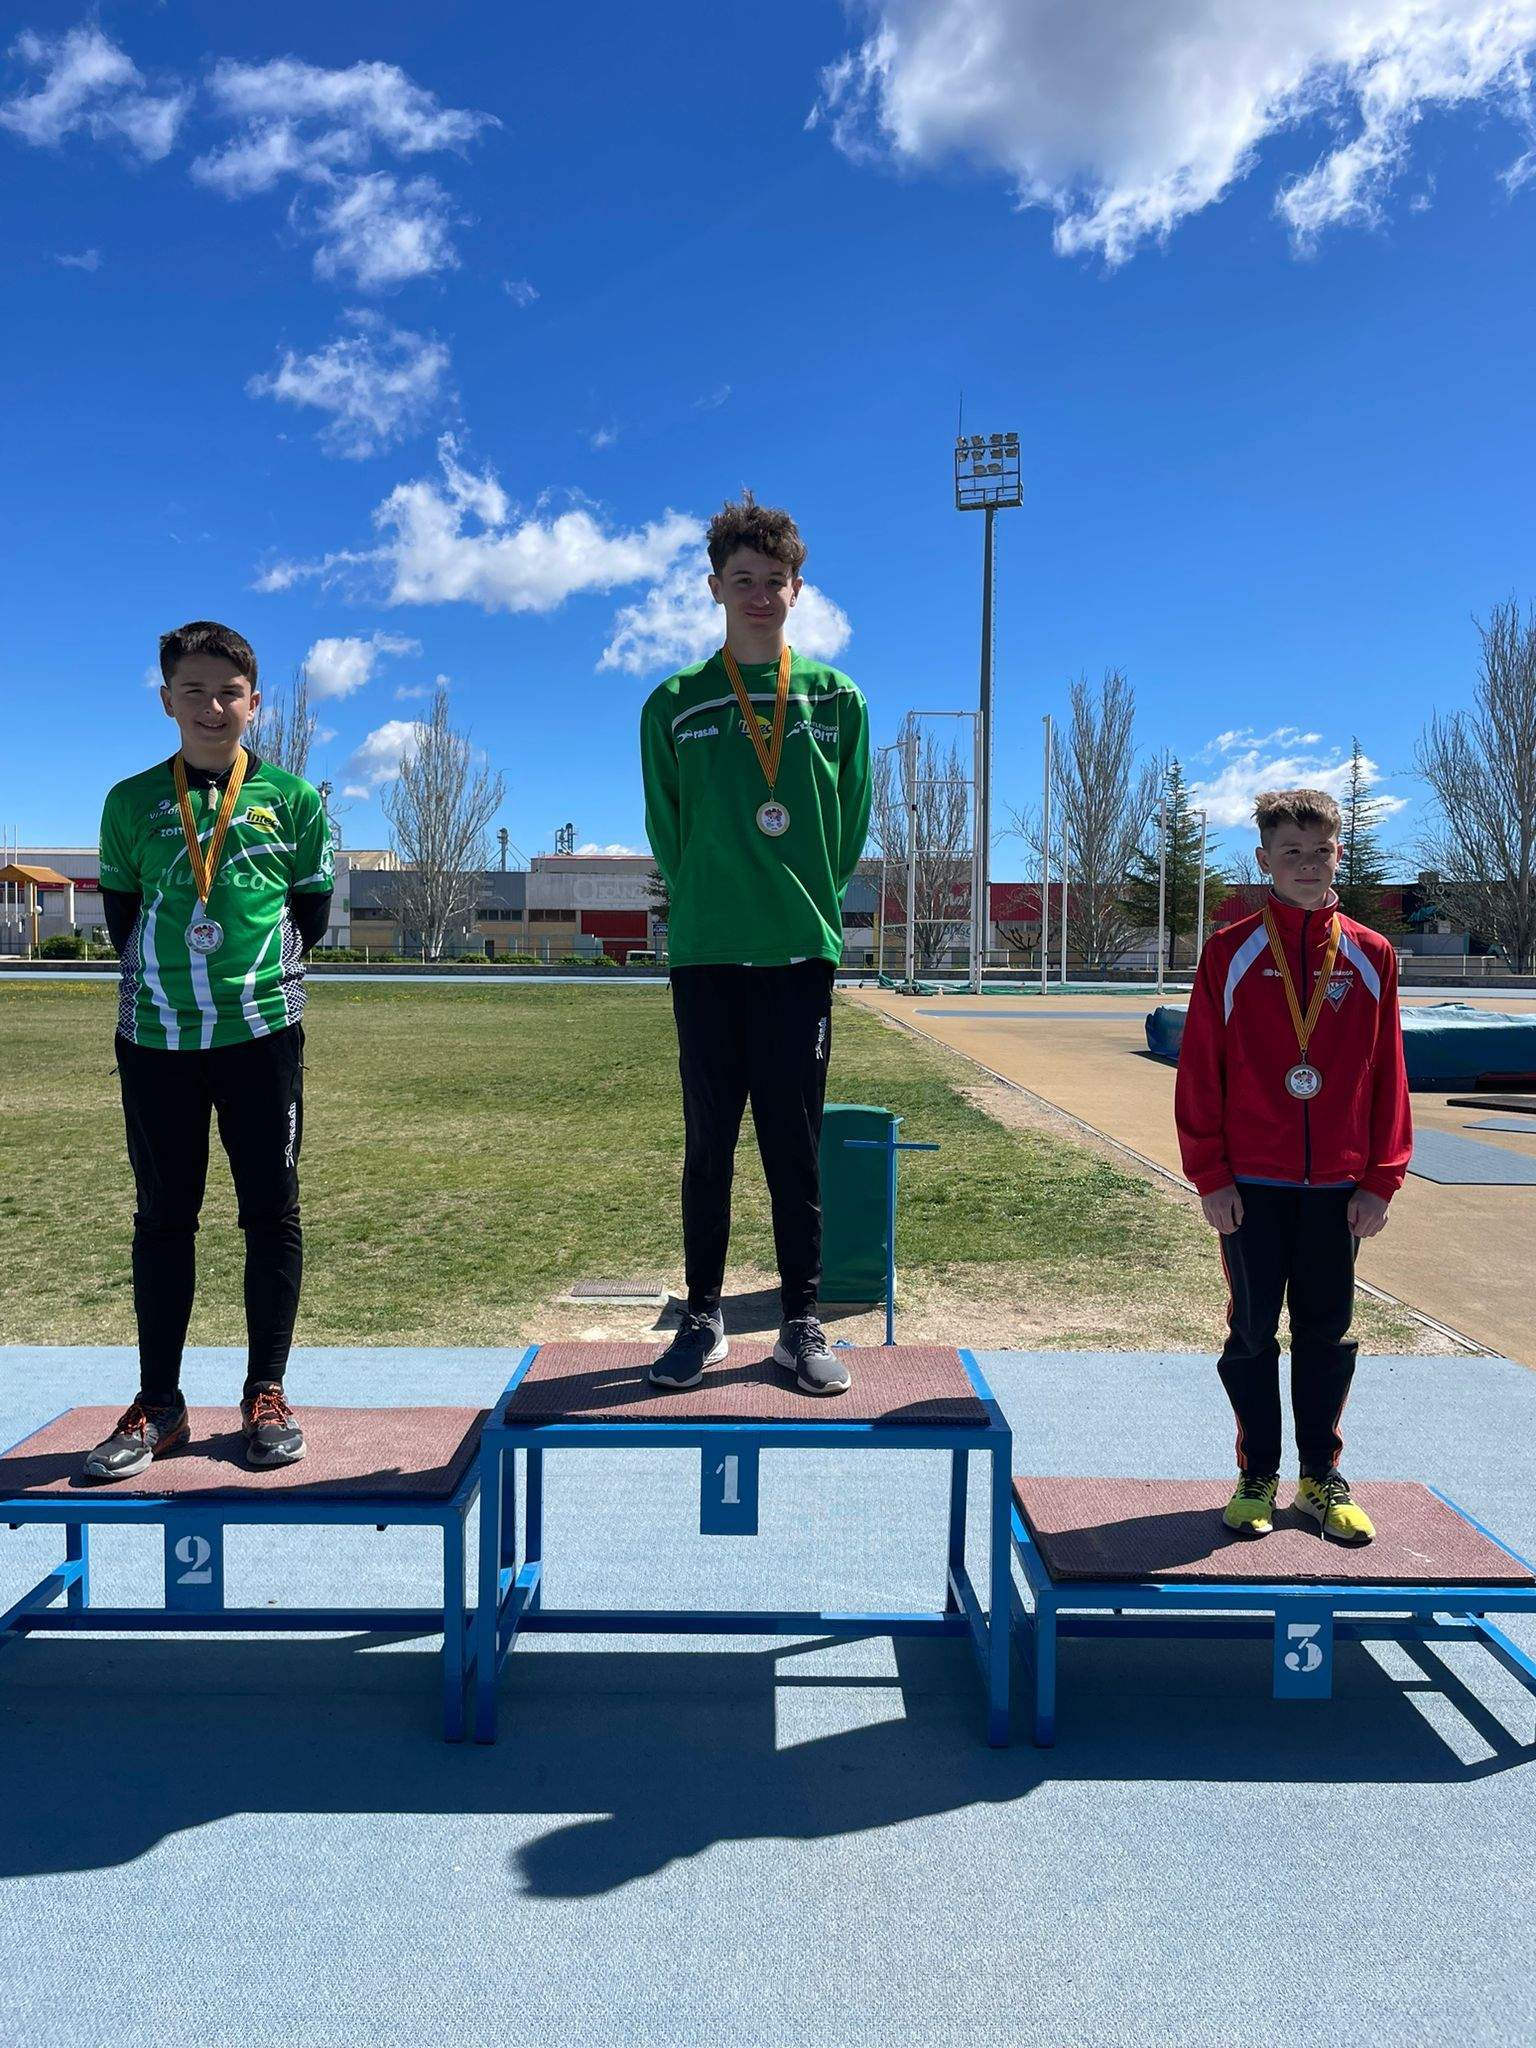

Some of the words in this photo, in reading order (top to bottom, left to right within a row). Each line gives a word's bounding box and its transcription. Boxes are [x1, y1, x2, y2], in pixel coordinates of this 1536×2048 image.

[156, 867, 267, 891] Husca
[715, 1454, 741, 1504] 1
[174, 1535, 213, 1585] 2
[1283, 1623, 1323, 1672] 3
